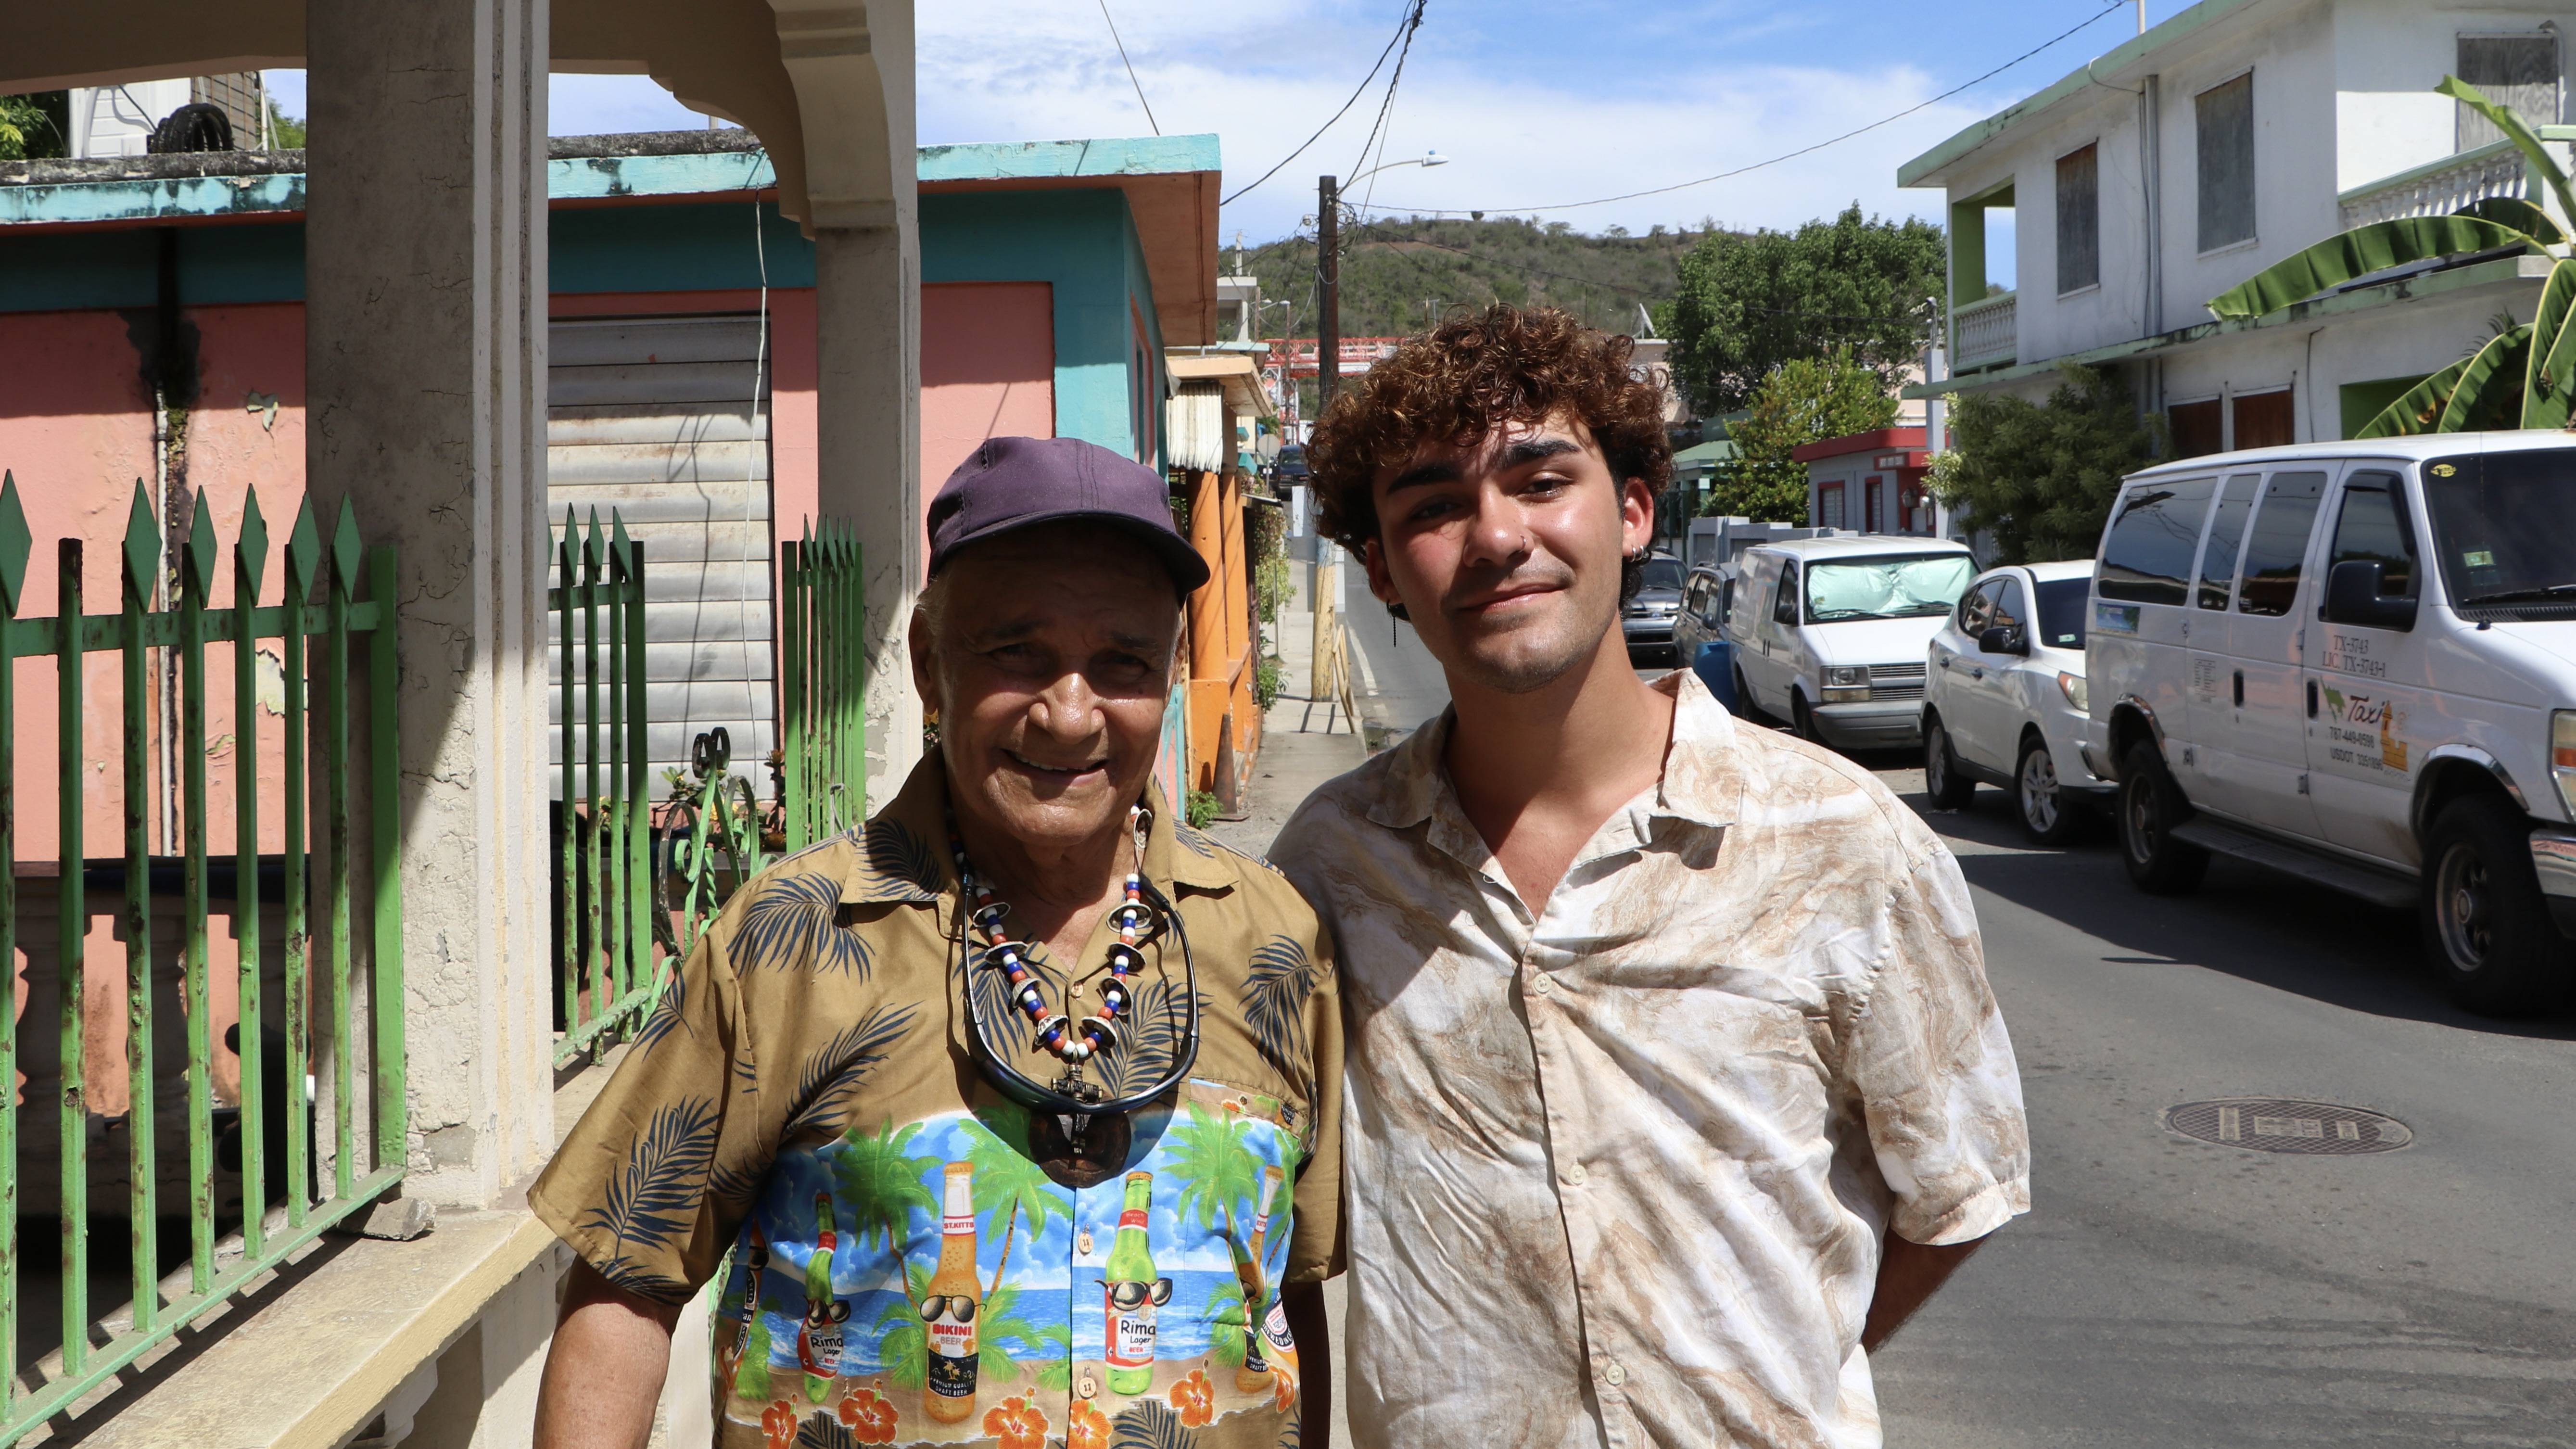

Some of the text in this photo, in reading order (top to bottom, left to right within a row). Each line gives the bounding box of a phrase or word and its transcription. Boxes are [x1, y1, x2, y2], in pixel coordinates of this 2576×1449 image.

[2334, 635, 2369, 654] TX-3743
[2322, 651, 2386, 677] LIC. TX-3743-1
[2348, 695, 2386, 724] Taxi
[2330, 747, 2353, 763] USDOT
[933, 1324, 972, 1336] BIKINI
[1121, 1320, 1156, 1335] Rima
[810, 1336, 844, 1347] Rima
[940, 1336, 962, 1345] BEER
[1130, 1335, 1152, 1345] Lager
[823, 1347, 841, 1357] Lager
[930, 1377, 975, 1389] PREMIUM QUALITY
[935, 1386, 951, 1396] DRAFT
